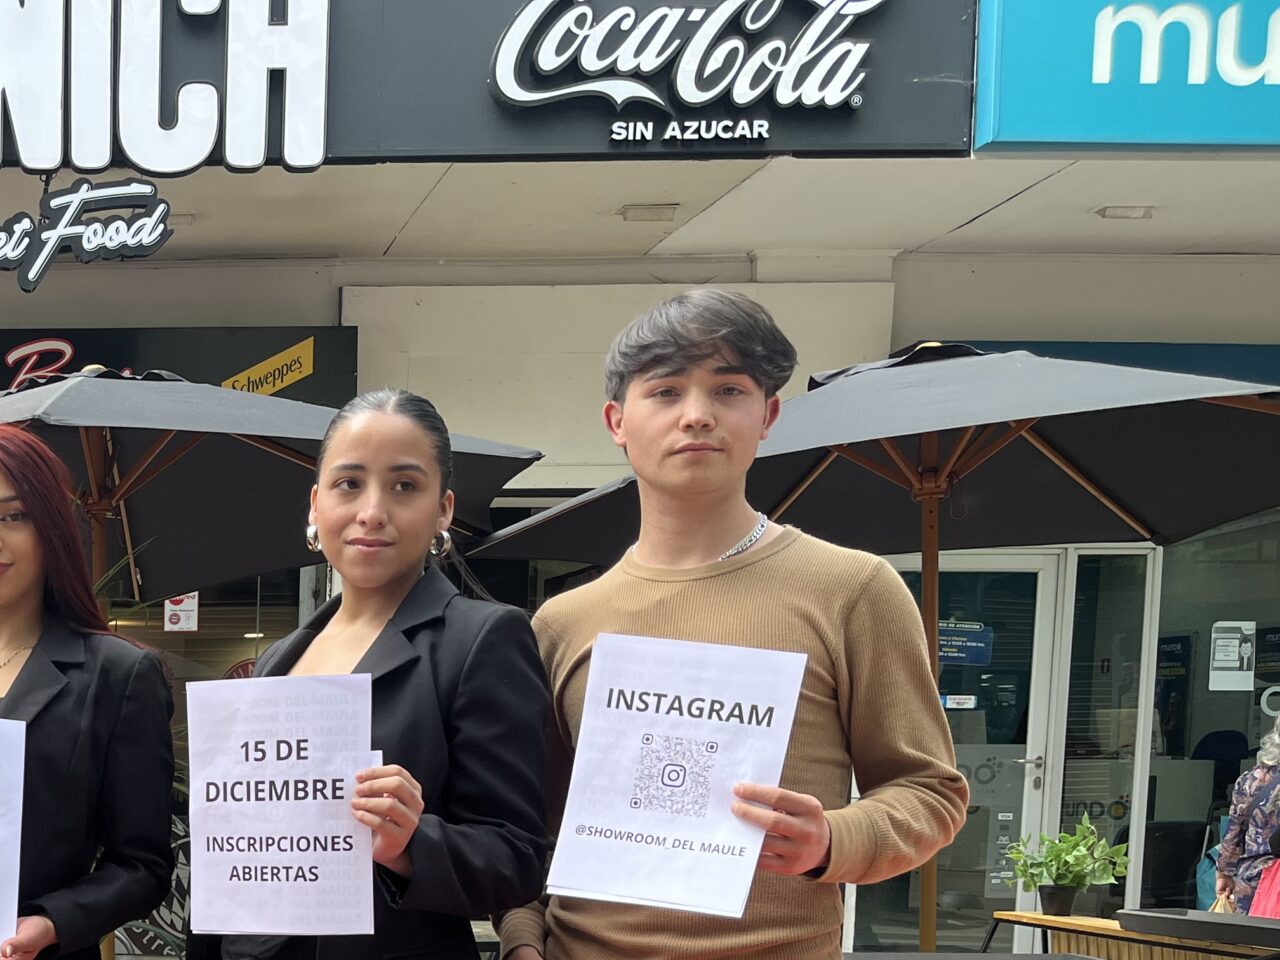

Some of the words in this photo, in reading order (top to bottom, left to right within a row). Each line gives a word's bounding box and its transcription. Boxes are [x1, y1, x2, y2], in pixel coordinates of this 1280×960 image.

[495, 0, 878, 107] Coca-Cola
[610, 120, 653, 141] SIN
[663, 119, 770, 141] AZUCAR
[27, 182, 168, 281] Food
[231, 355, 303, 393] Schweppes
[606, 687, 775, 728] INSTAGRAM
[240, 740, 267, 762] 15
[276, 739, 309, 761] DE
[205, 778, 345, 802] DICIEMBRE
[206, 835, 354, 853] INSCRIPCIONES
[699, 842, 747, 857] MAULE
[229, 865, 319, 882] ABIERTAS
